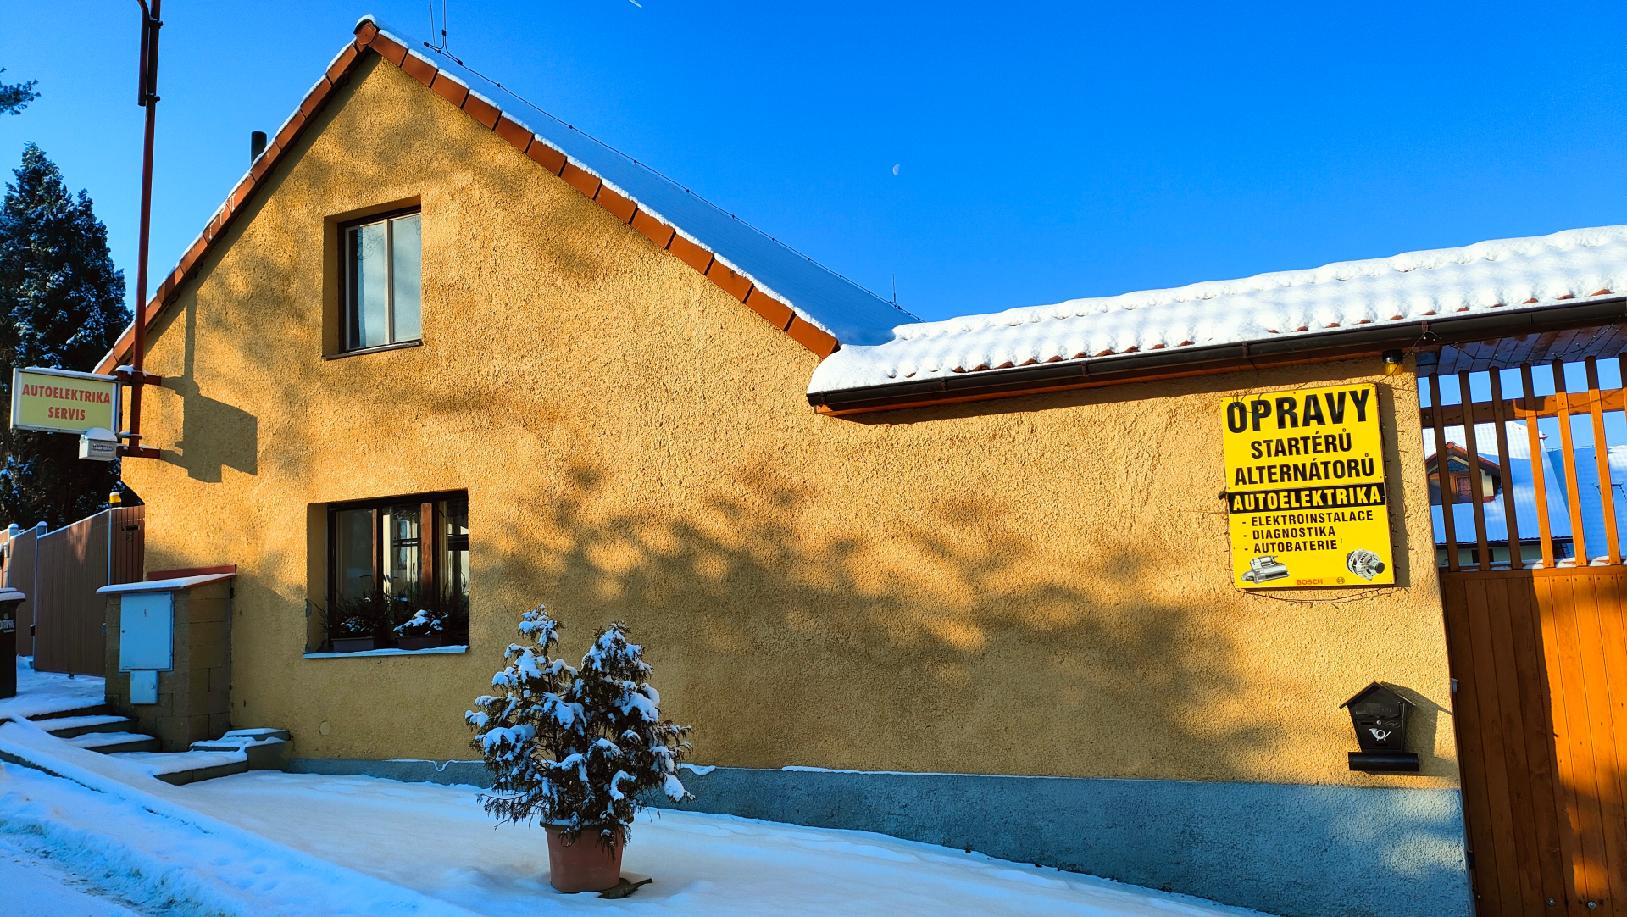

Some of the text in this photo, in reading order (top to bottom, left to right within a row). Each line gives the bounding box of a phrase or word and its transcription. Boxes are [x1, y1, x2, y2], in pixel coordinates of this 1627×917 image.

[22, 384, 111, 404] AUTOELEKTRIKA
[48, 406, 86, 421] SERVIS
[1226, 388, 1370, 433] OPRAVY
[1251, 428, 1352, 460] STARTÉRŮ
[1235, 453, 1375, 486] ALTERNÁTORŮ
[1233, 485, 1382, 511] AUTOELEKTRIKA
[1251, 510, 1374, 526] ELEKTROINSTALACE
[1252, 526, 1336, 540] DIAGNOSTIKA
[1253, 540, 1337, 554] AUTOBATERIE
[1296, 578, 1324, 586] BOSCH
